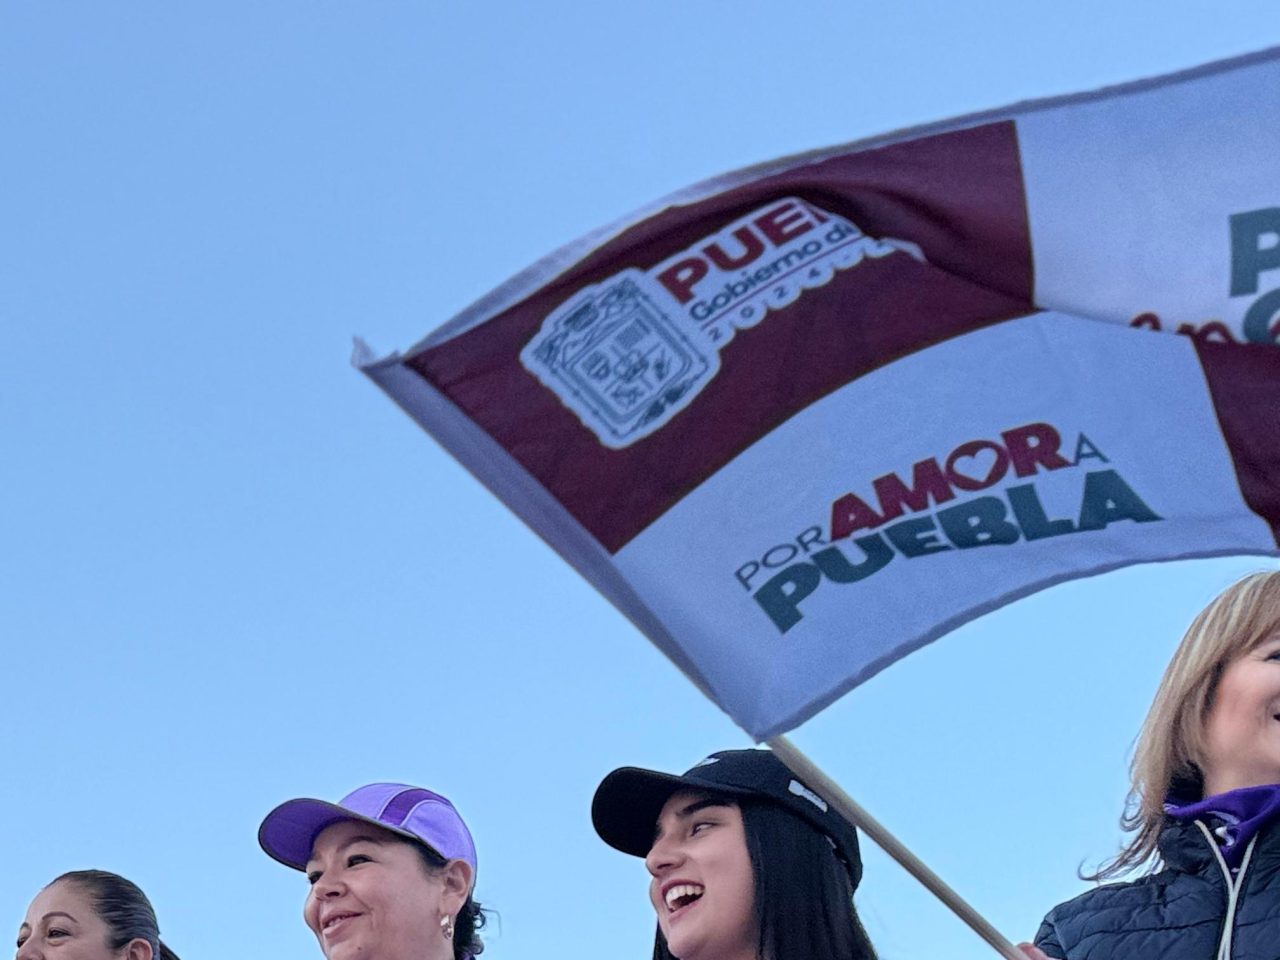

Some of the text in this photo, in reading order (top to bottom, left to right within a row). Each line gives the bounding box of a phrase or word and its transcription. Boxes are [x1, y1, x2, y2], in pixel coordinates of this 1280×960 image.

[689, 239, 822, 322] Gobierno
[734, 422, 1110, 592] POR AMOR A
[752, 468, 1166, 636] PUEBLA
